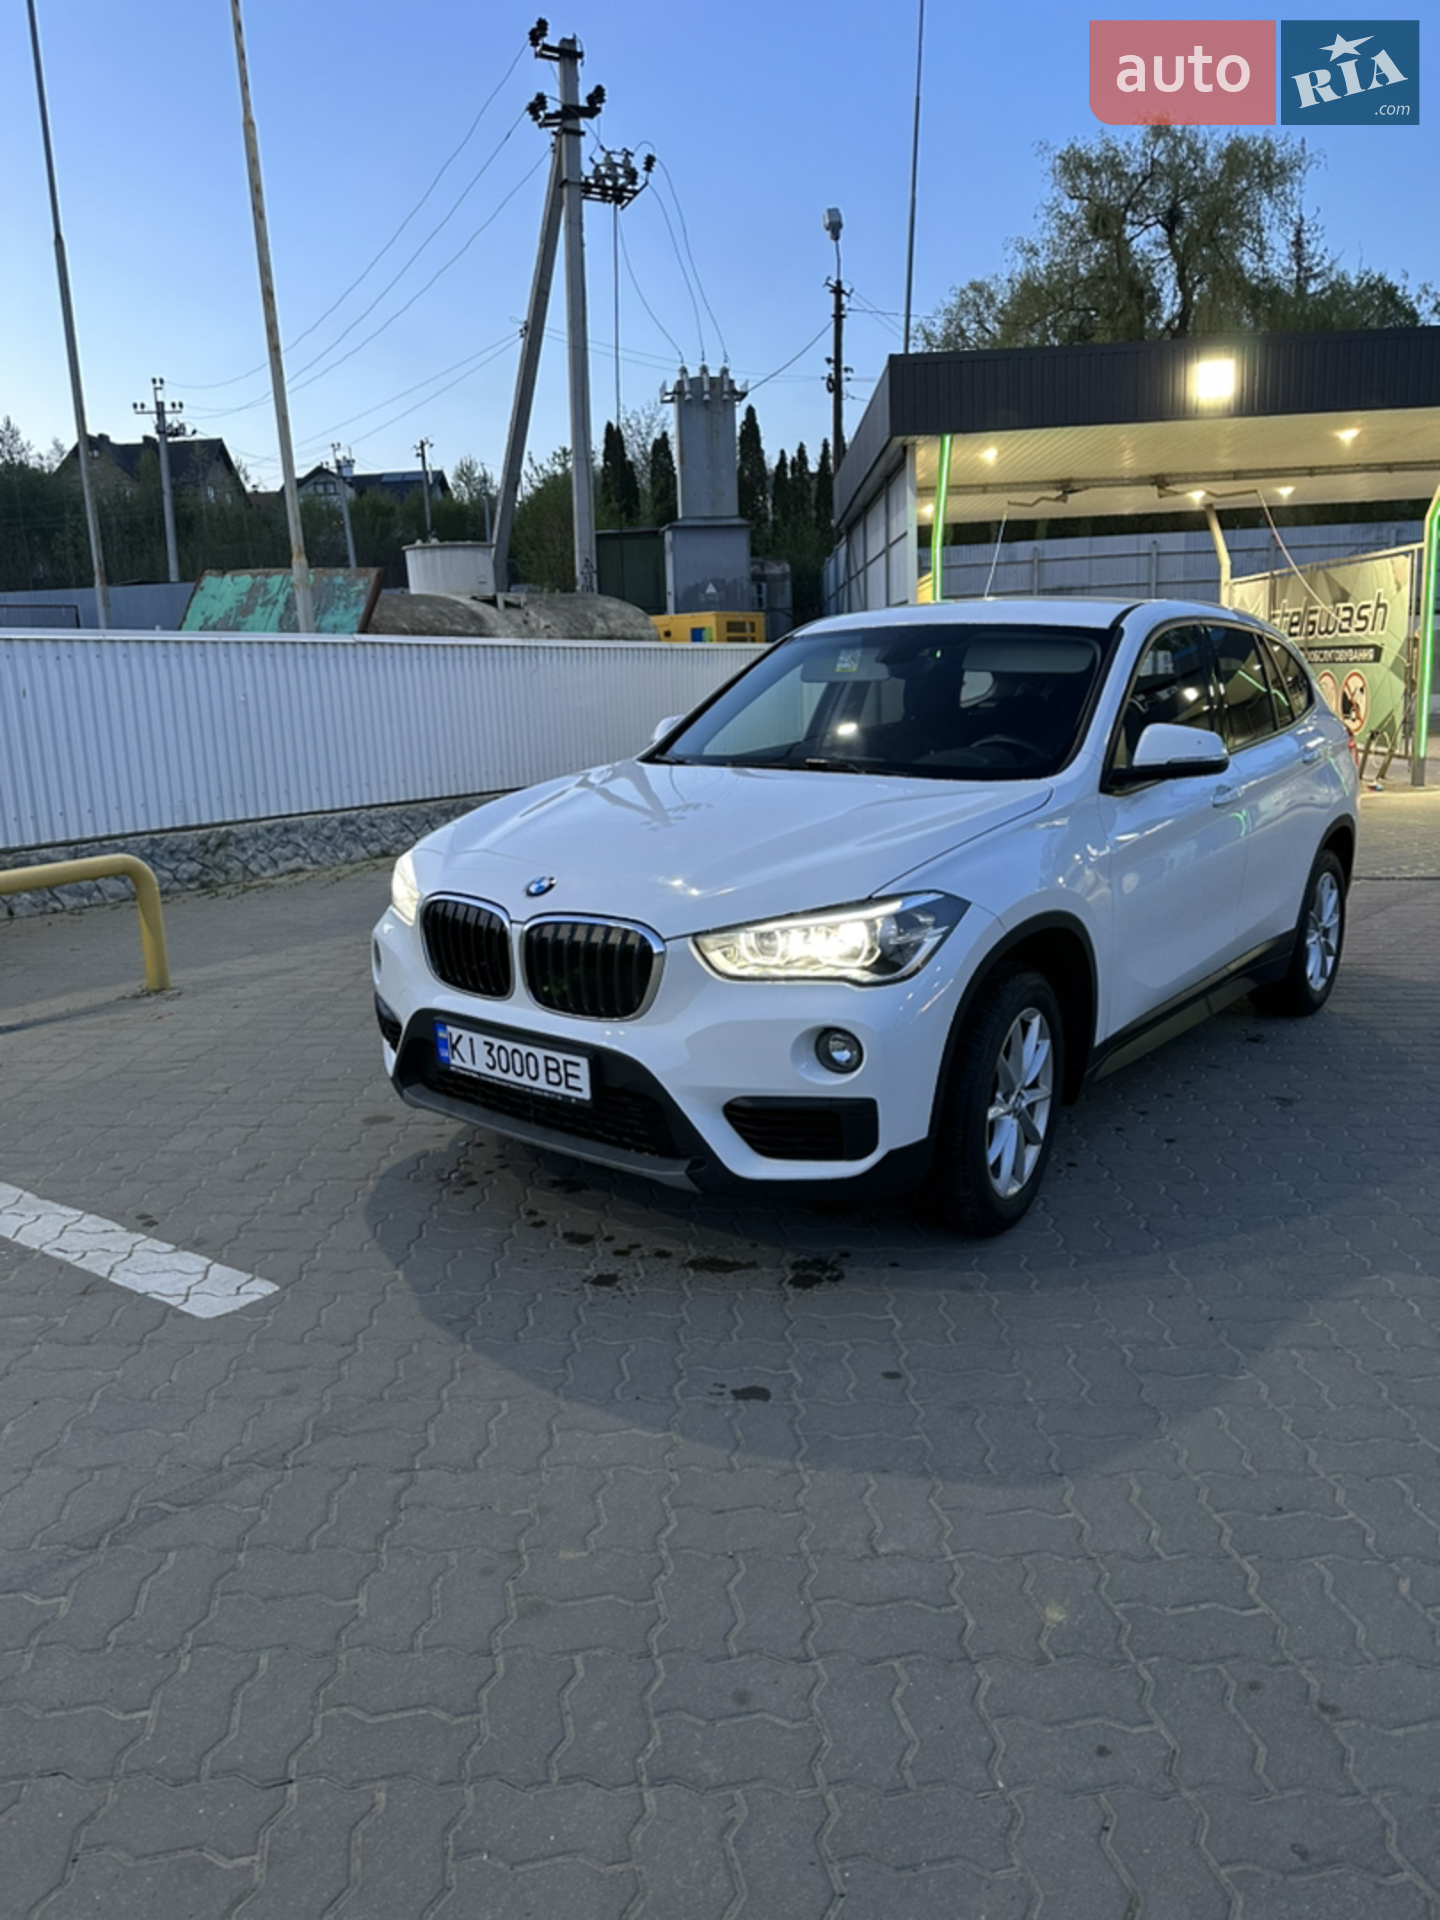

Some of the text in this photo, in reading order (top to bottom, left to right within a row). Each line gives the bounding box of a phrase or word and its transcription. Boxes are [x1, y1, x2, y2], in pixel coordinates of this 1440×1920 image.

[448, 1031, 584, 1093] KI 3000 BE
